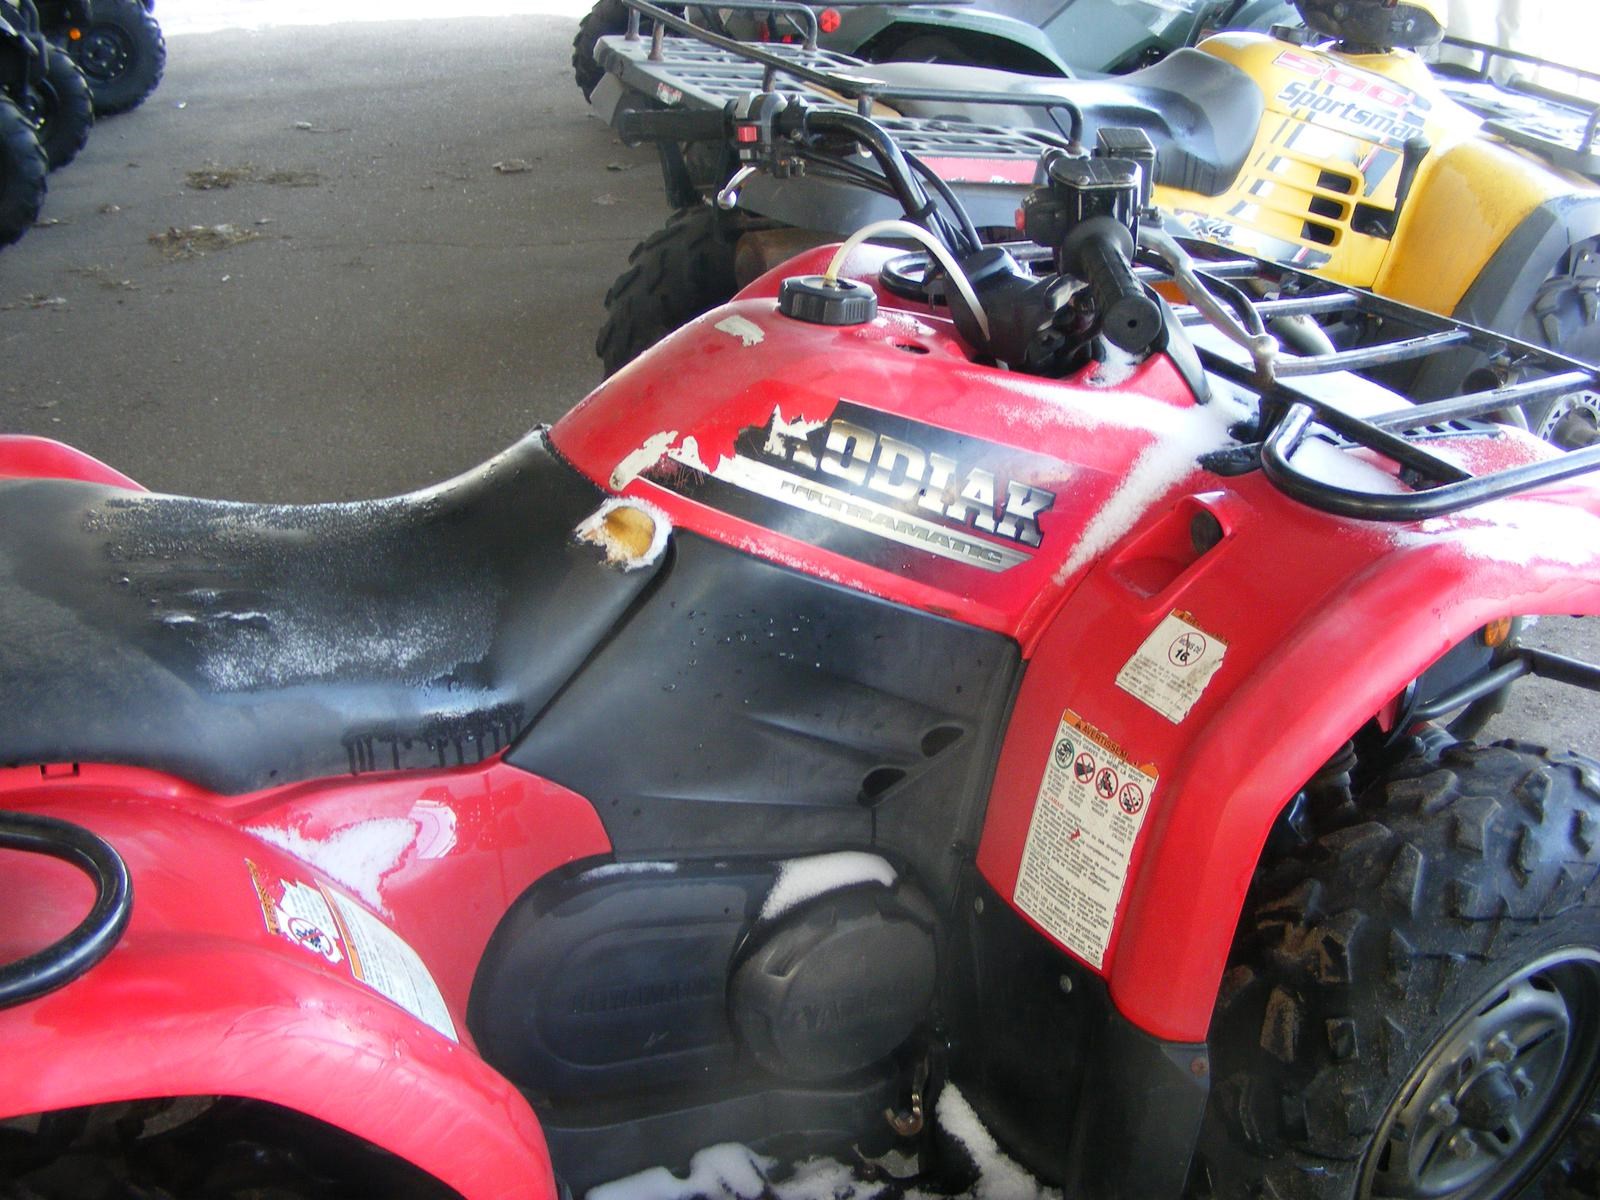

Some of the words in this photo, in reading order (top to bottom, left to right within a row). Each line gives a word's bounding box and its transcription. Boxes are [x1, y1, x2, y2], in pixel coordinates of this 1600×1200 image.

[1273, 51, 1408, 107] 500
[1278, 82, 1424, 141] Sportsman
[763, 406, 1057, 548] KODIAK
[1175, 648, 1190, 662] 16
[1083, 723, 1137, 767] AVERTISSEM
